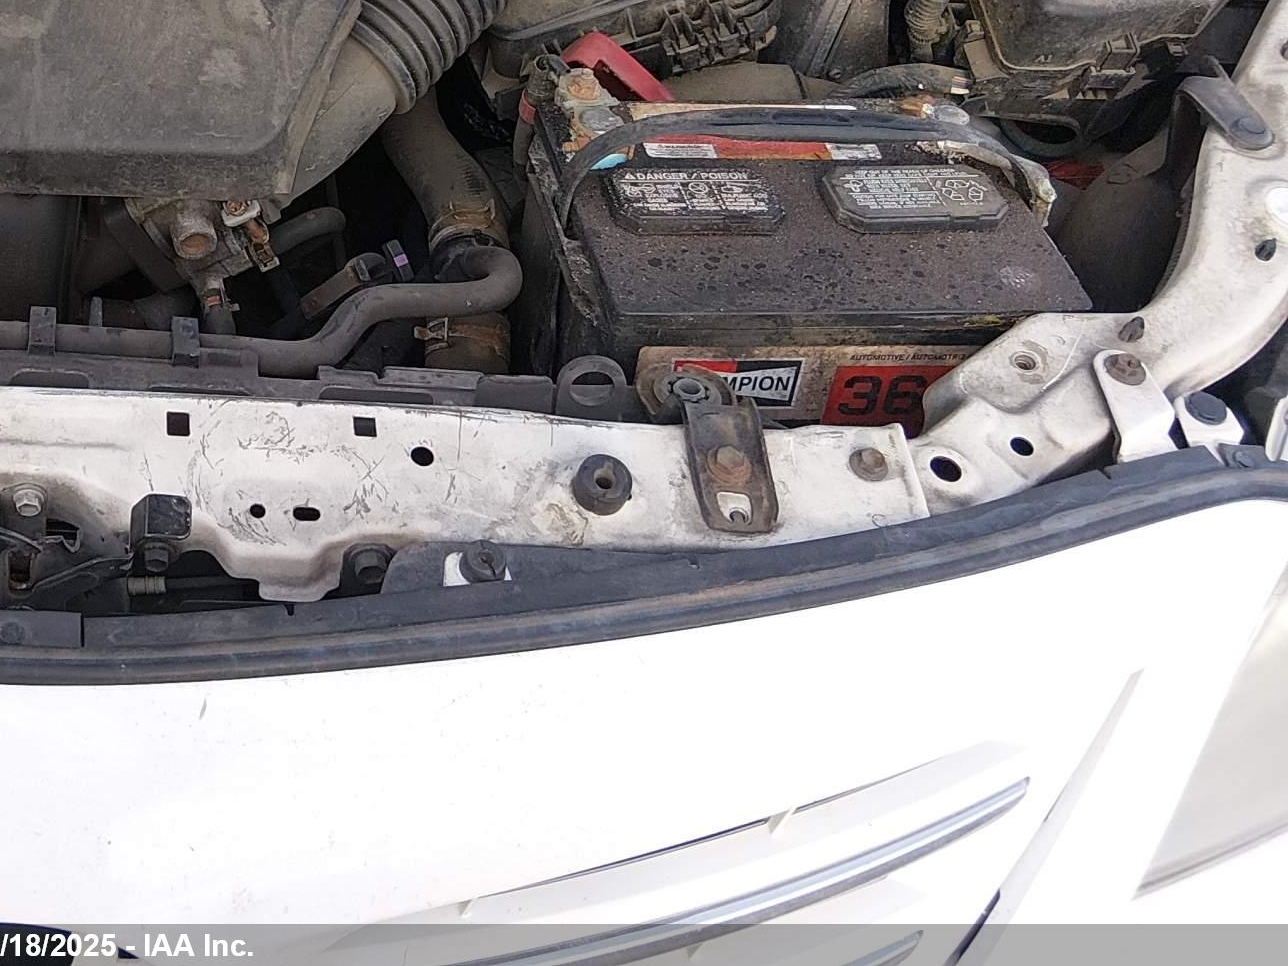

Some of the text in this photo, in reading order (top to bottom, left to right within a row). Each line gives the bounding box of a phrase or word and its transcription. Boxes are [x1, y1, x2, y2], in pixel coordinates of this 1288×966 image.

[635, 172, 688, 180] DANGER
[701, 172, 748, 180] POISON
[850, 353, 904, 361] AUTOMOTIVE
[721, 376, 791, 391] MPION
[838, 375, 929, 415] 36
